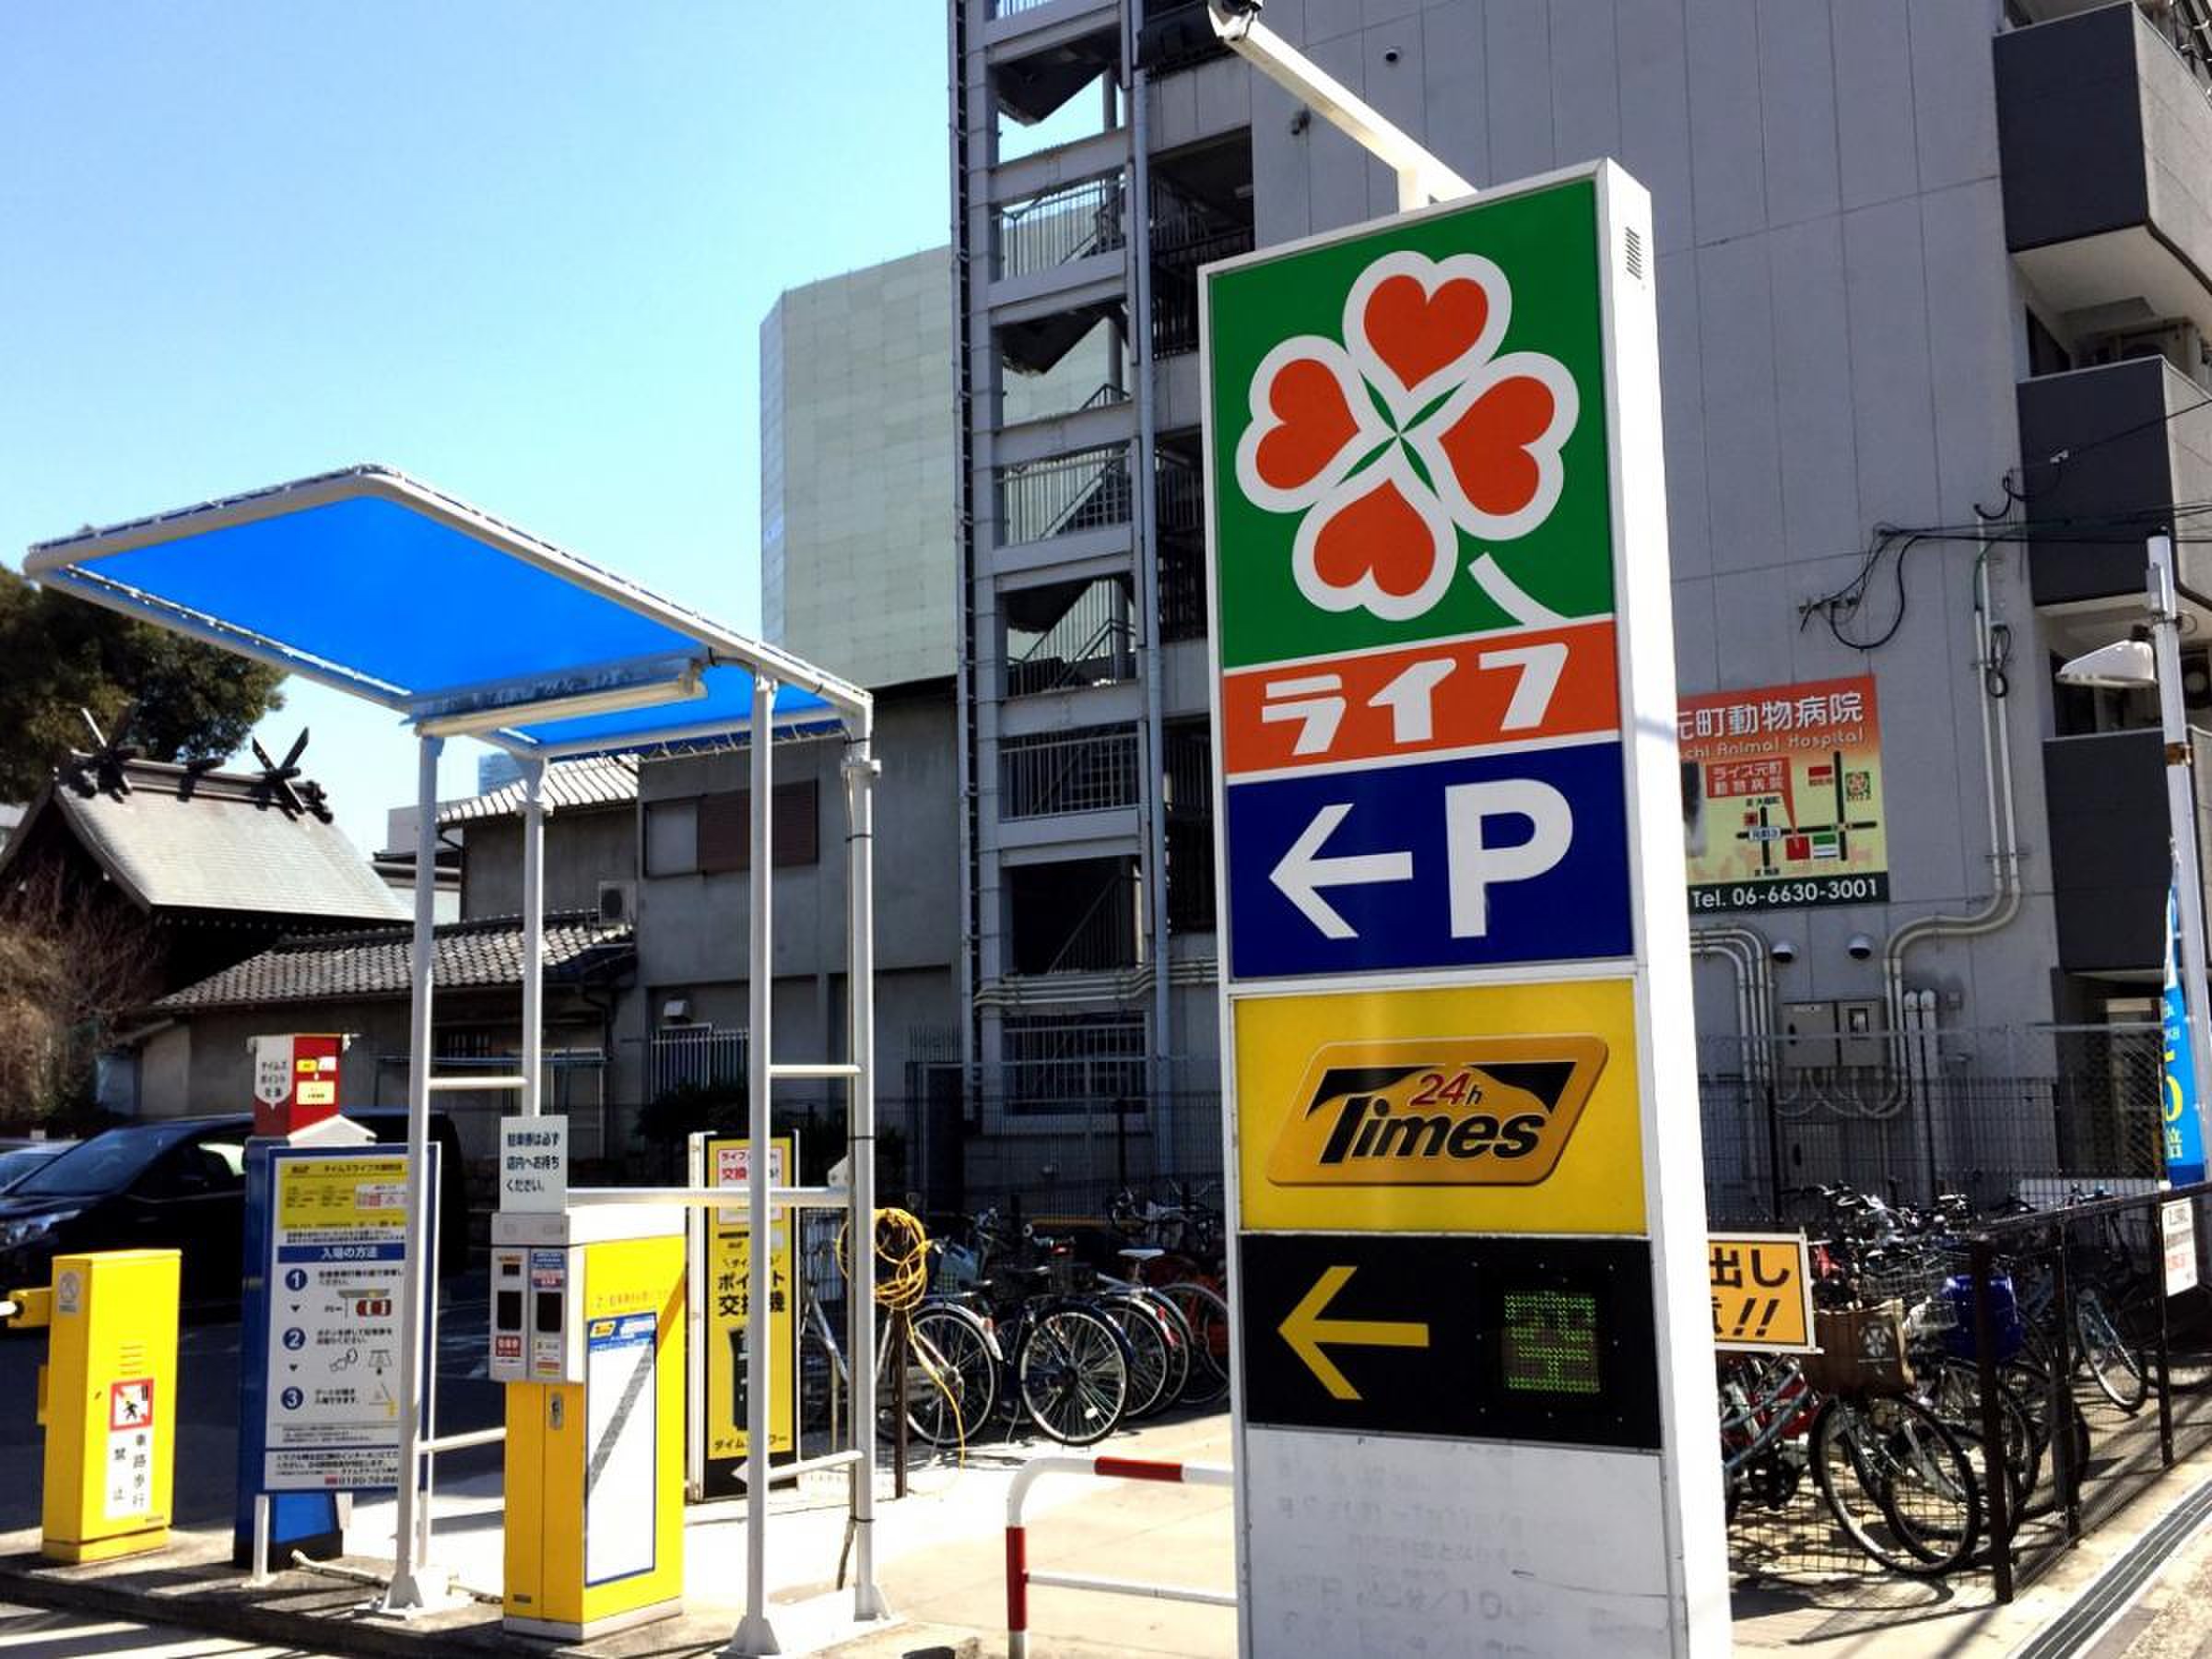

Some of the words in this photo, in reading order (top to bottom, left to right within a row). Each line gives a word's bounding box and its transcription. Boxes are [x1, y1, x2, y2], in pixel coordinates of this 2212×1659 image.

[1262, 642, 1569, 756] ライフ
[1677, 692, 1863, 740] 元町動物病院
[1717, 738, 1780, 756] Animal
[1788, 727, 1864, 748] Hospital
[1444, 779, 1574, 938] P
[1691, 889, 1726, 909] Tel.
[1732, 878, 1878, 906] 06-6630-3001
[1409, 1072, 1482, 1107] 24h
[1319, 1096, 1546, 1166] Times
[322, 1246, 379, 1260] 入場の方法
[718, 1271, 785, 1291] ポイト
[1503, 1291, 1601, 1394] 空
